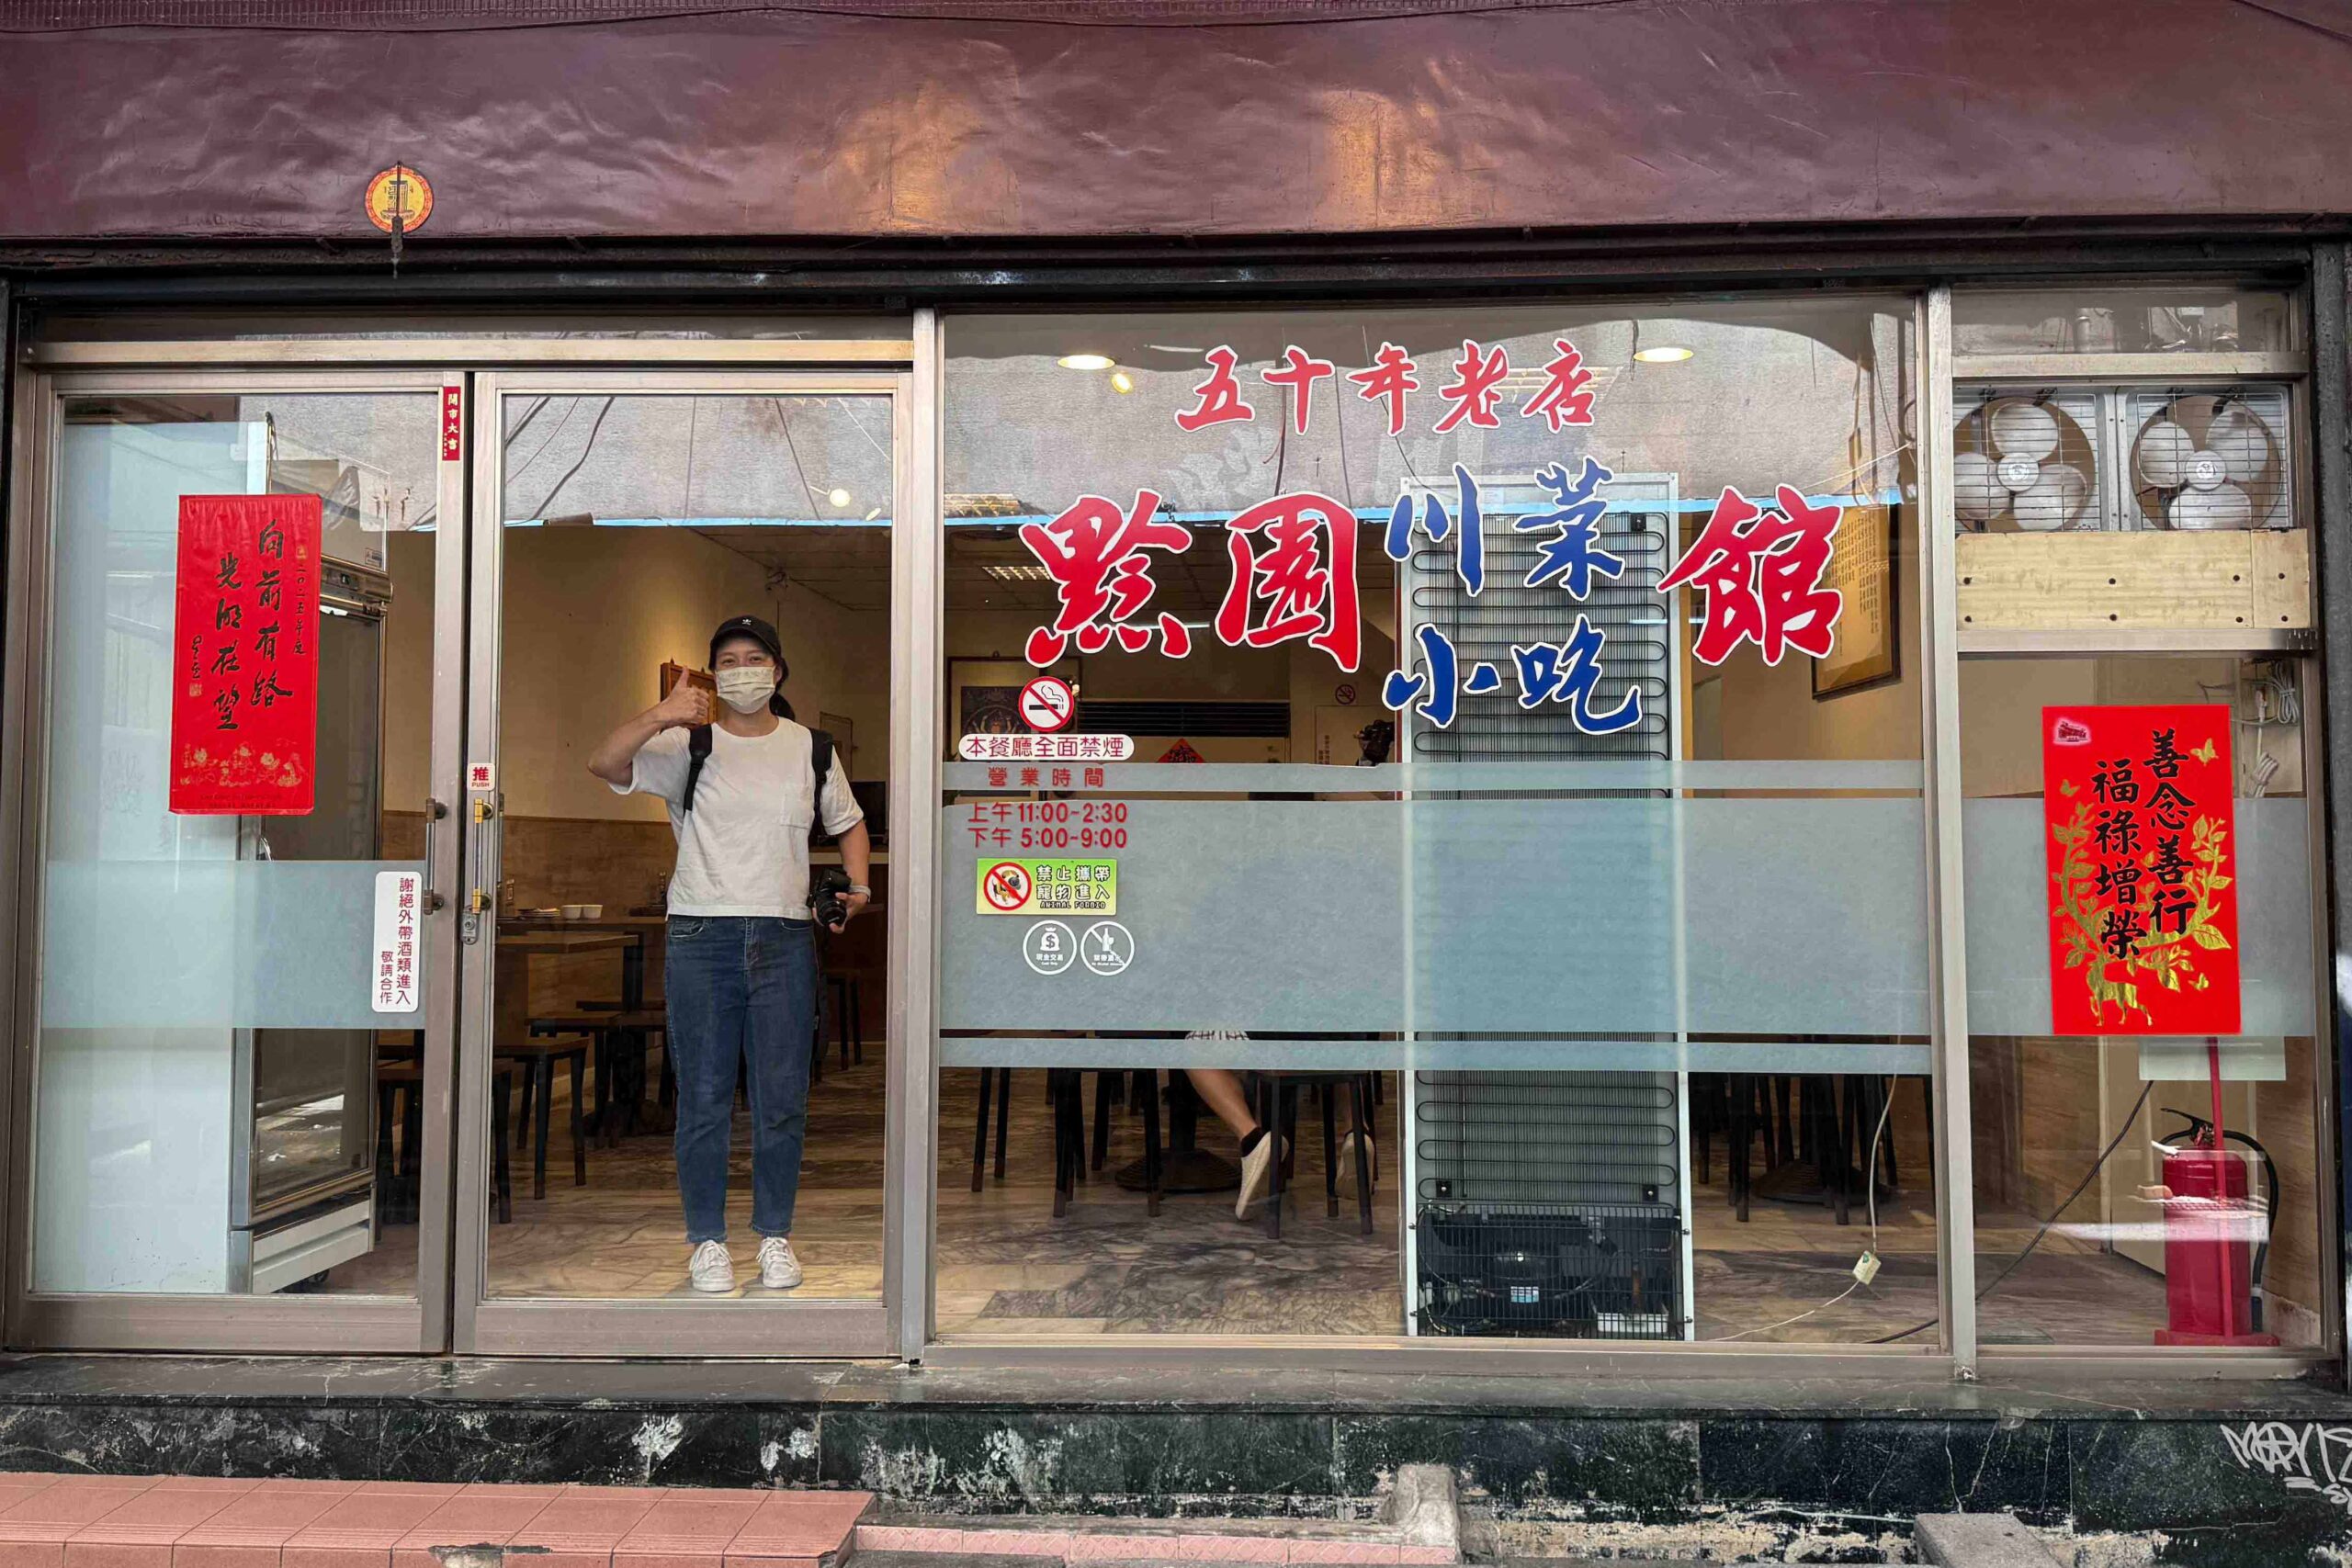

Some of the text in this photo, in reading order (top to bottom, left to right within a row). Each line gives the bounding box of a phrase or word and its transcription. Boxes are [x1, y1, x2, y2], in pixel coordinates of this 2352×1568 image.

[1175, 338, 1595, 436] 五十年老店
[1385, 456, 1624, 602] 川菜
[1656, 483, 1845, 666] 館
[211, 552, 243, 730] 光明在望
[251, 519, 293, 707] 向前有路
[1382, 614, 1643, 736] 小吃
[472, 767, 489, 781] 推
[966, 736, 1125, 758] 本餐廳全面禁煙
[988, 766, 1105, 788] 營業時間
[967, 802, 1012, 823] 上午
[967, 827, 1128, 849] 下午 5:00-9:00
[2143, 728, 2197, 936] 善念善行
[1036, 864, 1111, 882] 禁止攜帶
[1036, 884, 1111, 900] 寵物進入
[2091, 758, 2147, 960] 福祿增榮
[379, 951, 394, 1005] 敬請合作
[396, 878, 414, 1005] 謝絕外帶酒類進入
